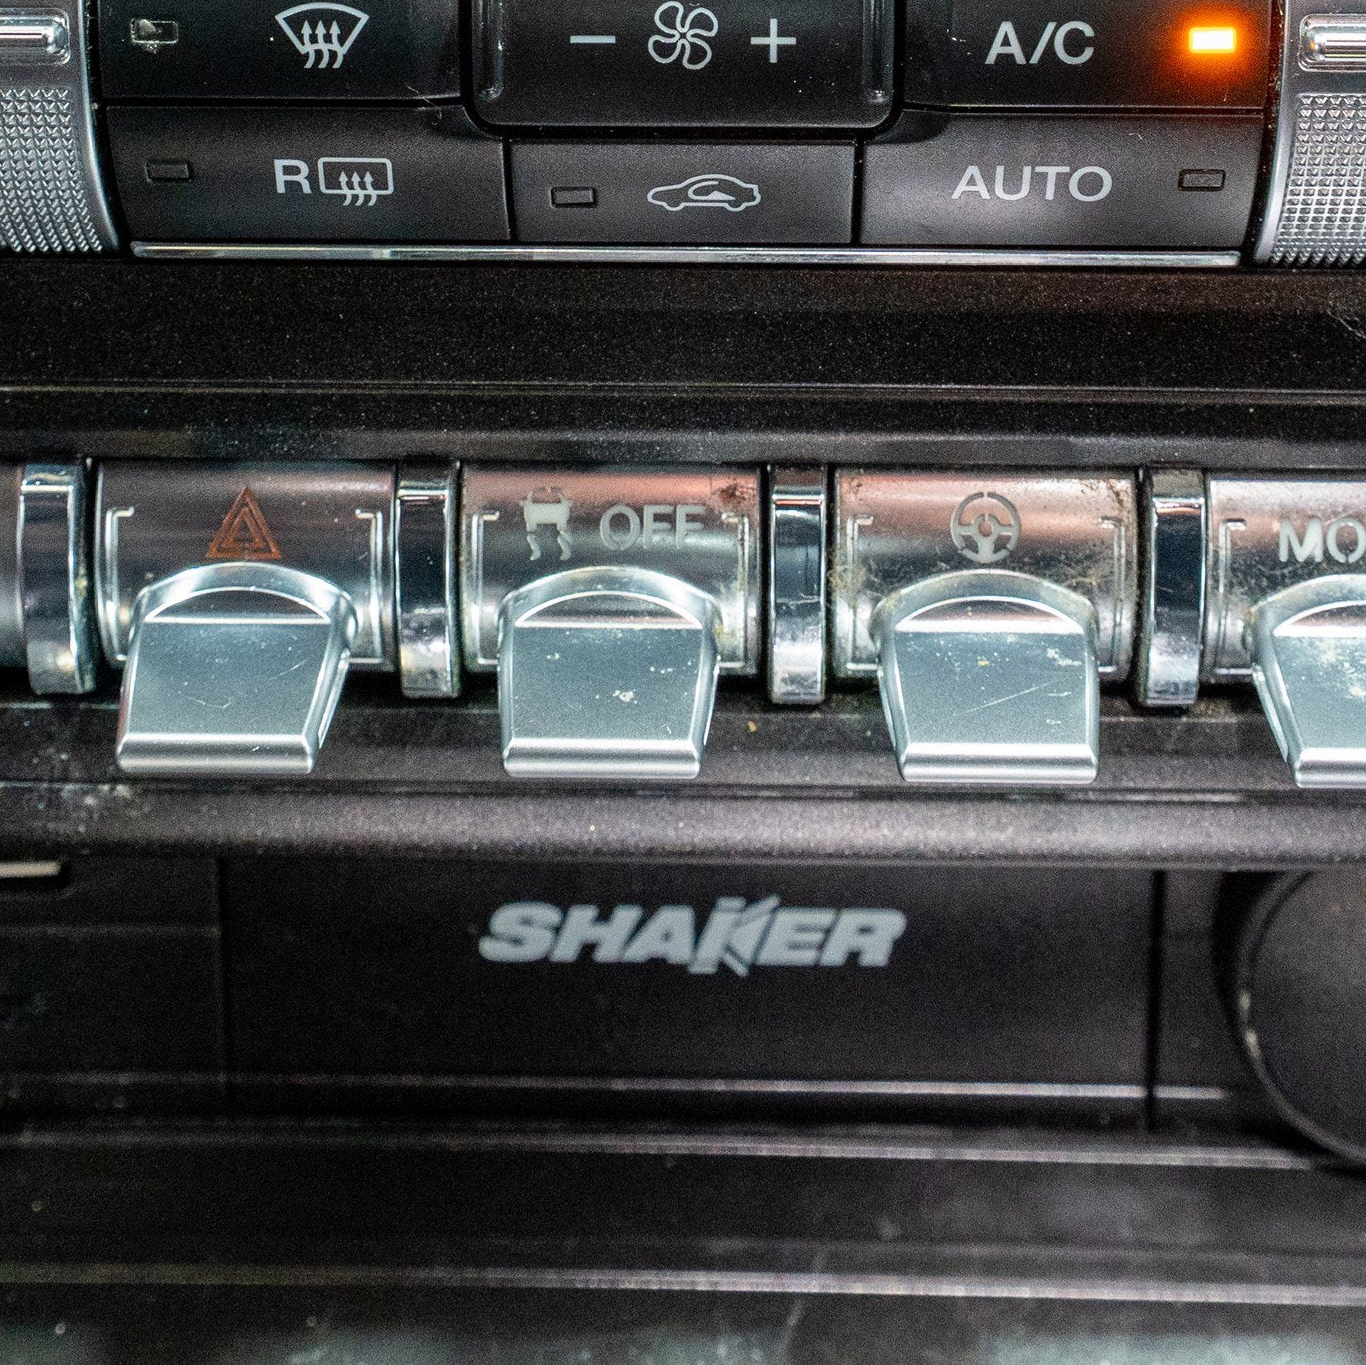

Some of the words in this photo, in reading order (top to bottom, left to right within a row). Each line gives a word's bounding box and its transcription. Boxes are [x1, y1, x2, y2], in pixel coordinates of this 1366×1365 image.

[984, 19, 1096, 66] A/C
[274, 157, 311, 194] R
[950, 165, 1113, 203] AUTO
[598, 503, 706, 551] OFF
[477, 895, 908, 977] SHAKER
